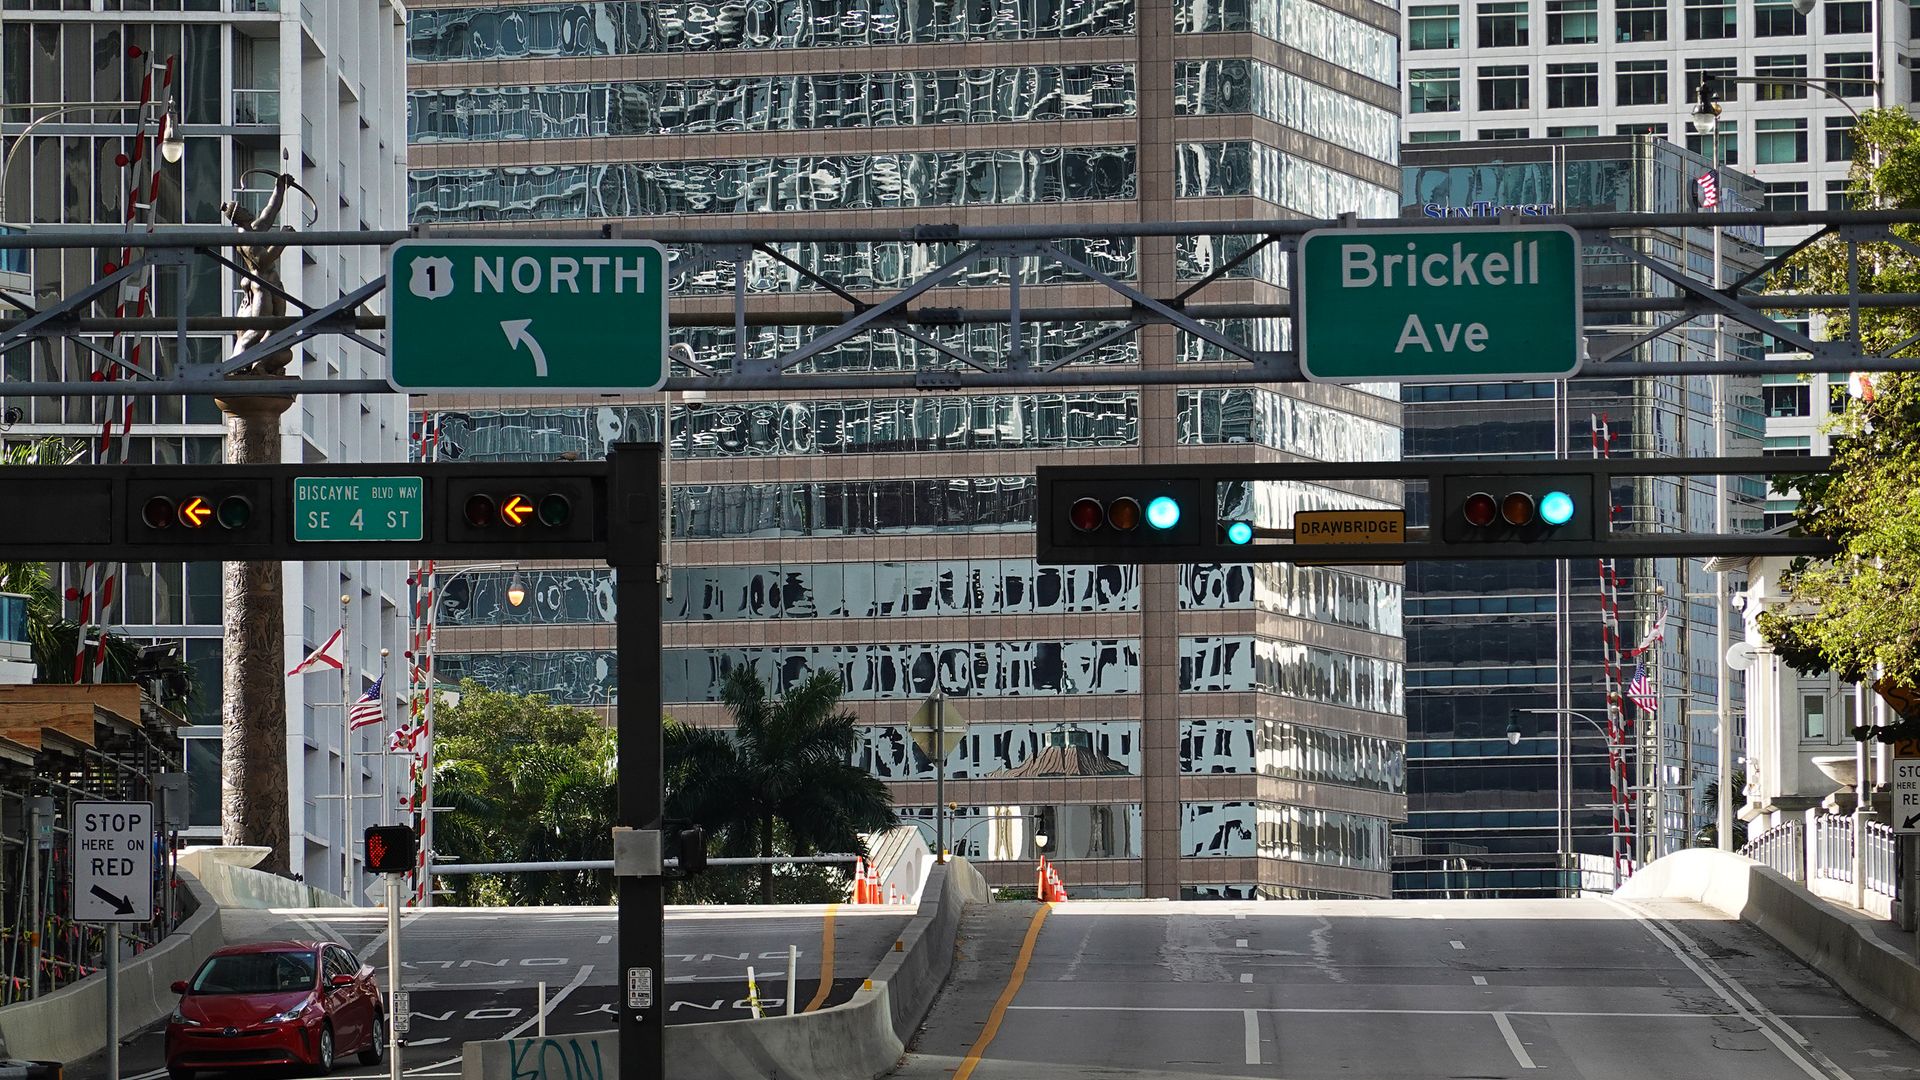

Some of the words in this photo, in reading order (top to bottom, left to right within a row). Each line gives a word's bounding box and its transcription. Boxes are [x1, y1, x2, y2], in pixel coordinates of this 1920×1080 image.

[1341, 240, 1539, 288] Brickell
[426, 265, 436, 292] 1
[473, 255, 646, 294] NORTH
[1394, 314, 1489, 353] Ave
[299, 485, 360, 501] BISCAYNE
[371, 486, 394, 499] BLVD
[398, 486, 418, 499] WAY
[308, 511, 330, 528] SE
[349, 508, 364, 531] 4
[386, 510, 409, 528] ST
[1301, 520, 1398, 534] DRAWBRIDGE
[1899, 766, 1920, 778] STO
[1897, 782, 1917, 790] HERE
[1903, 793, 1919, 806] RE
[85, 813, 141, 832] STOP
[82, 839, 114, 851] HERE
[127, 839, 144, 851] ON
[92, 858, 134, 876] RED
